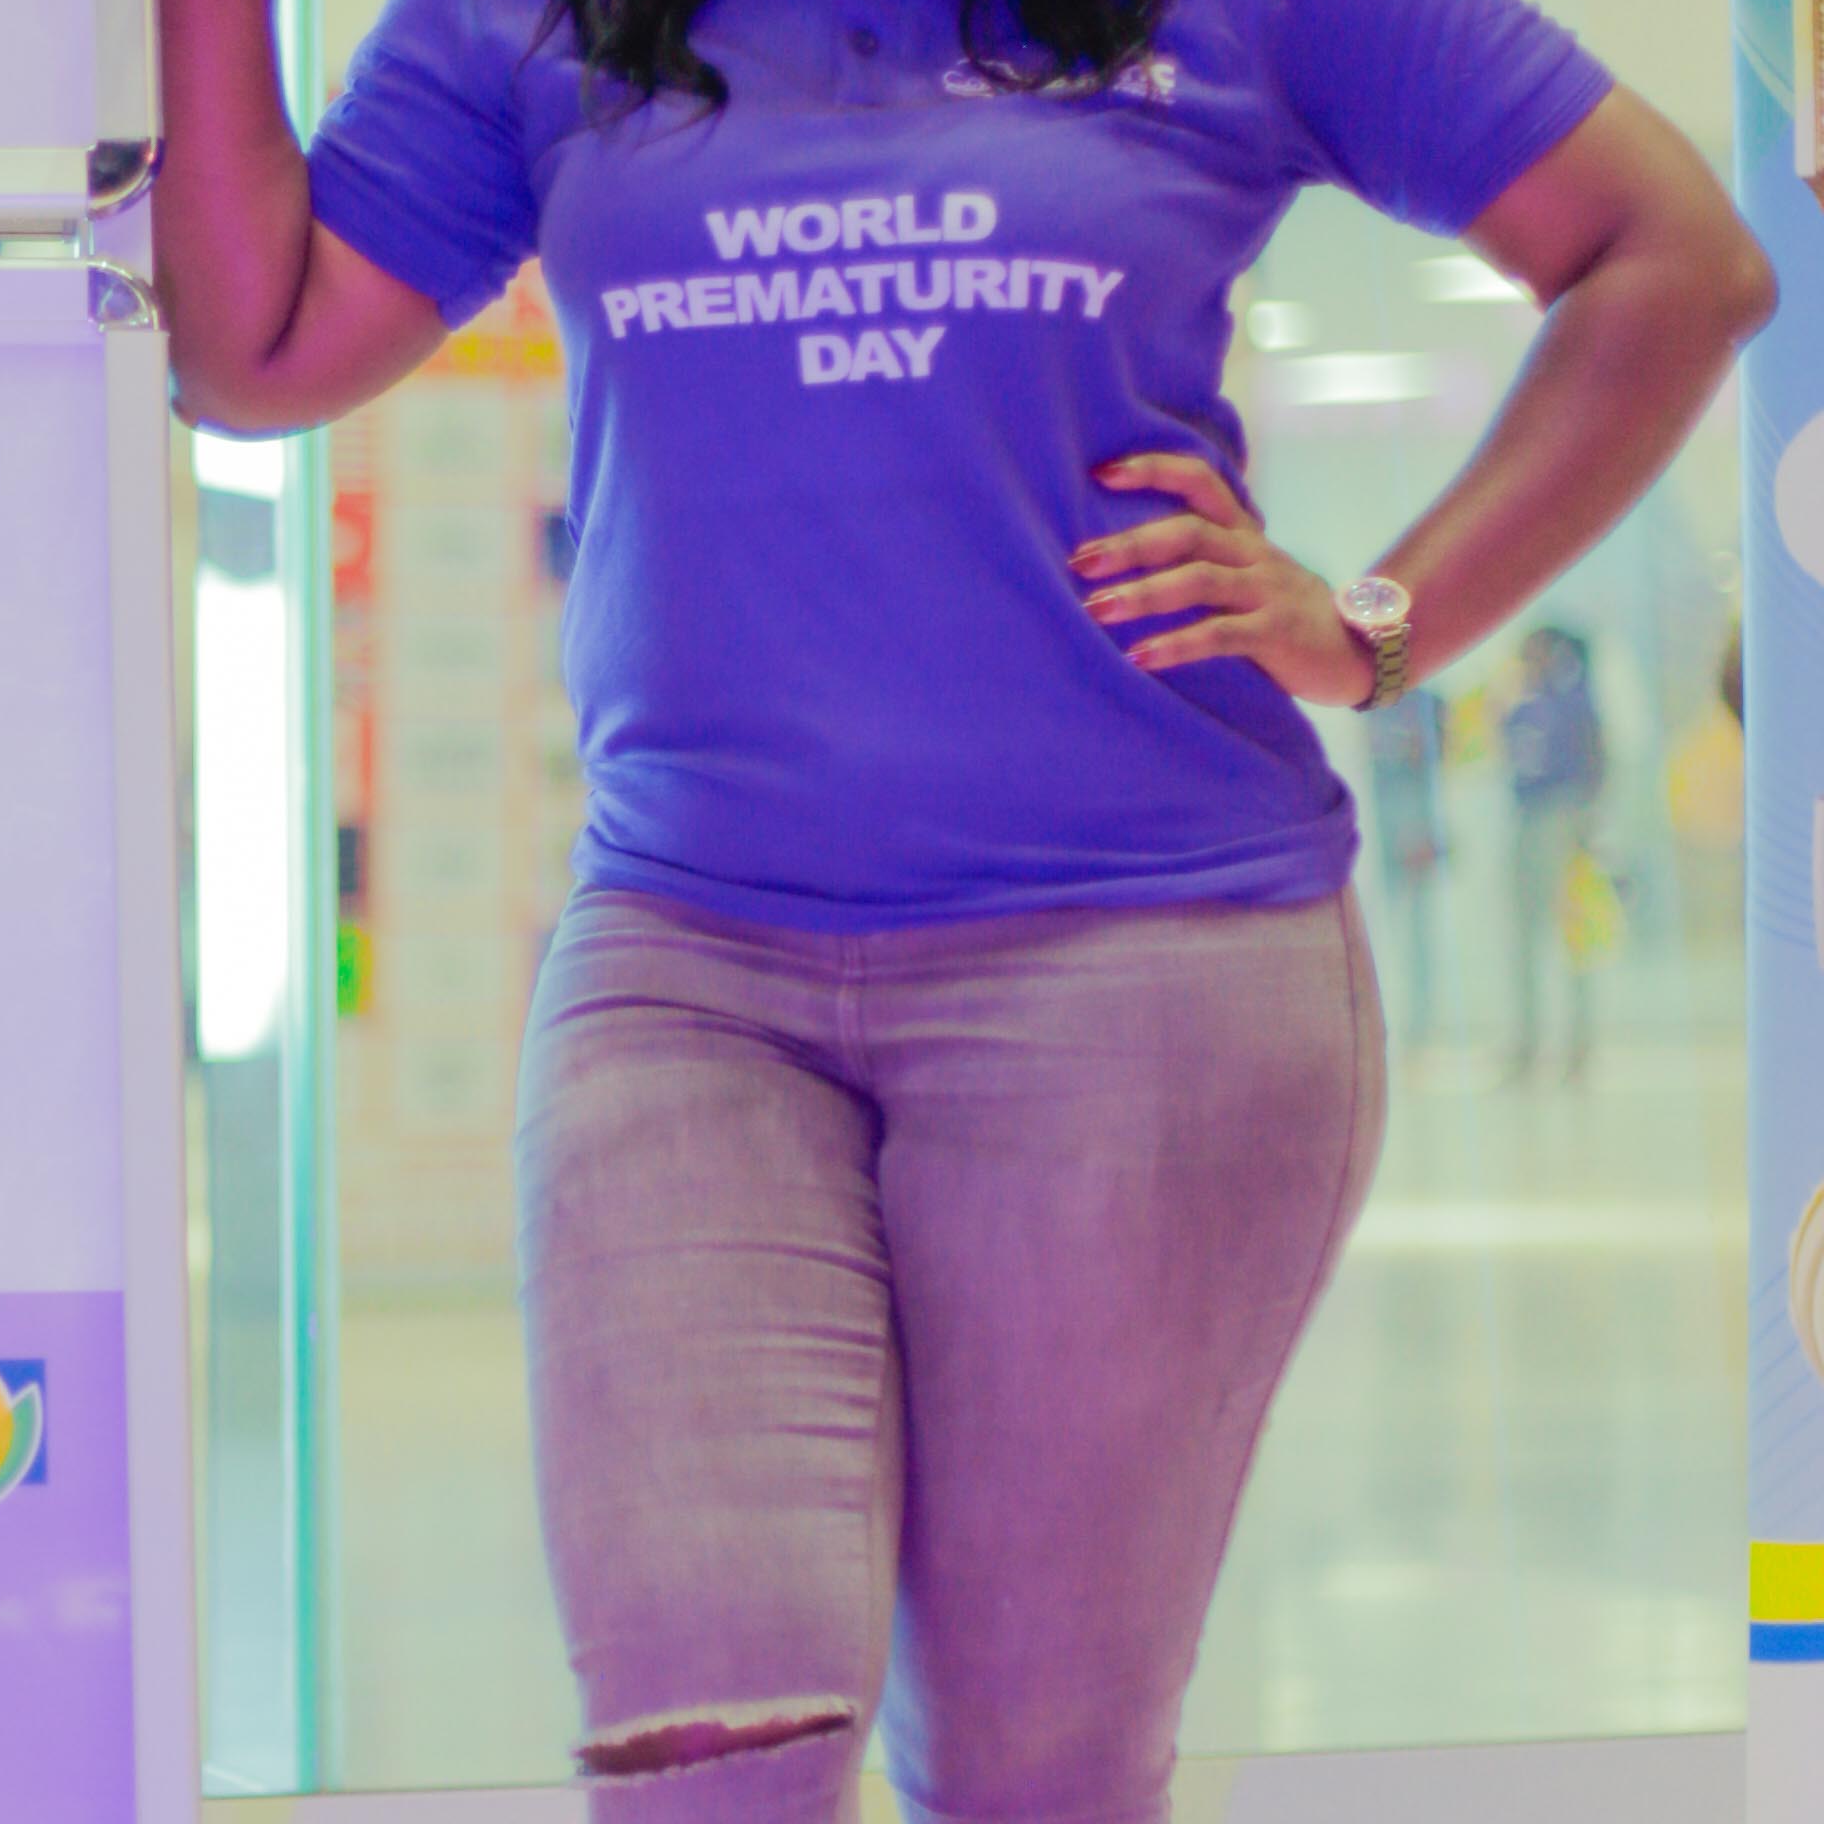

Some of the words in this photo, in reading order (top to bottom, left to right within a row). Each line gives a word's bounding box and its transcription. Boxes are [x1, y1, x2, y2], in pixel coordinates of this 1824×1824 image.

[705, 192, 998, 261] WORLD
[600, 259, 1125, 339] PREMATURITY
[798, 326, 947, 385] DAY
